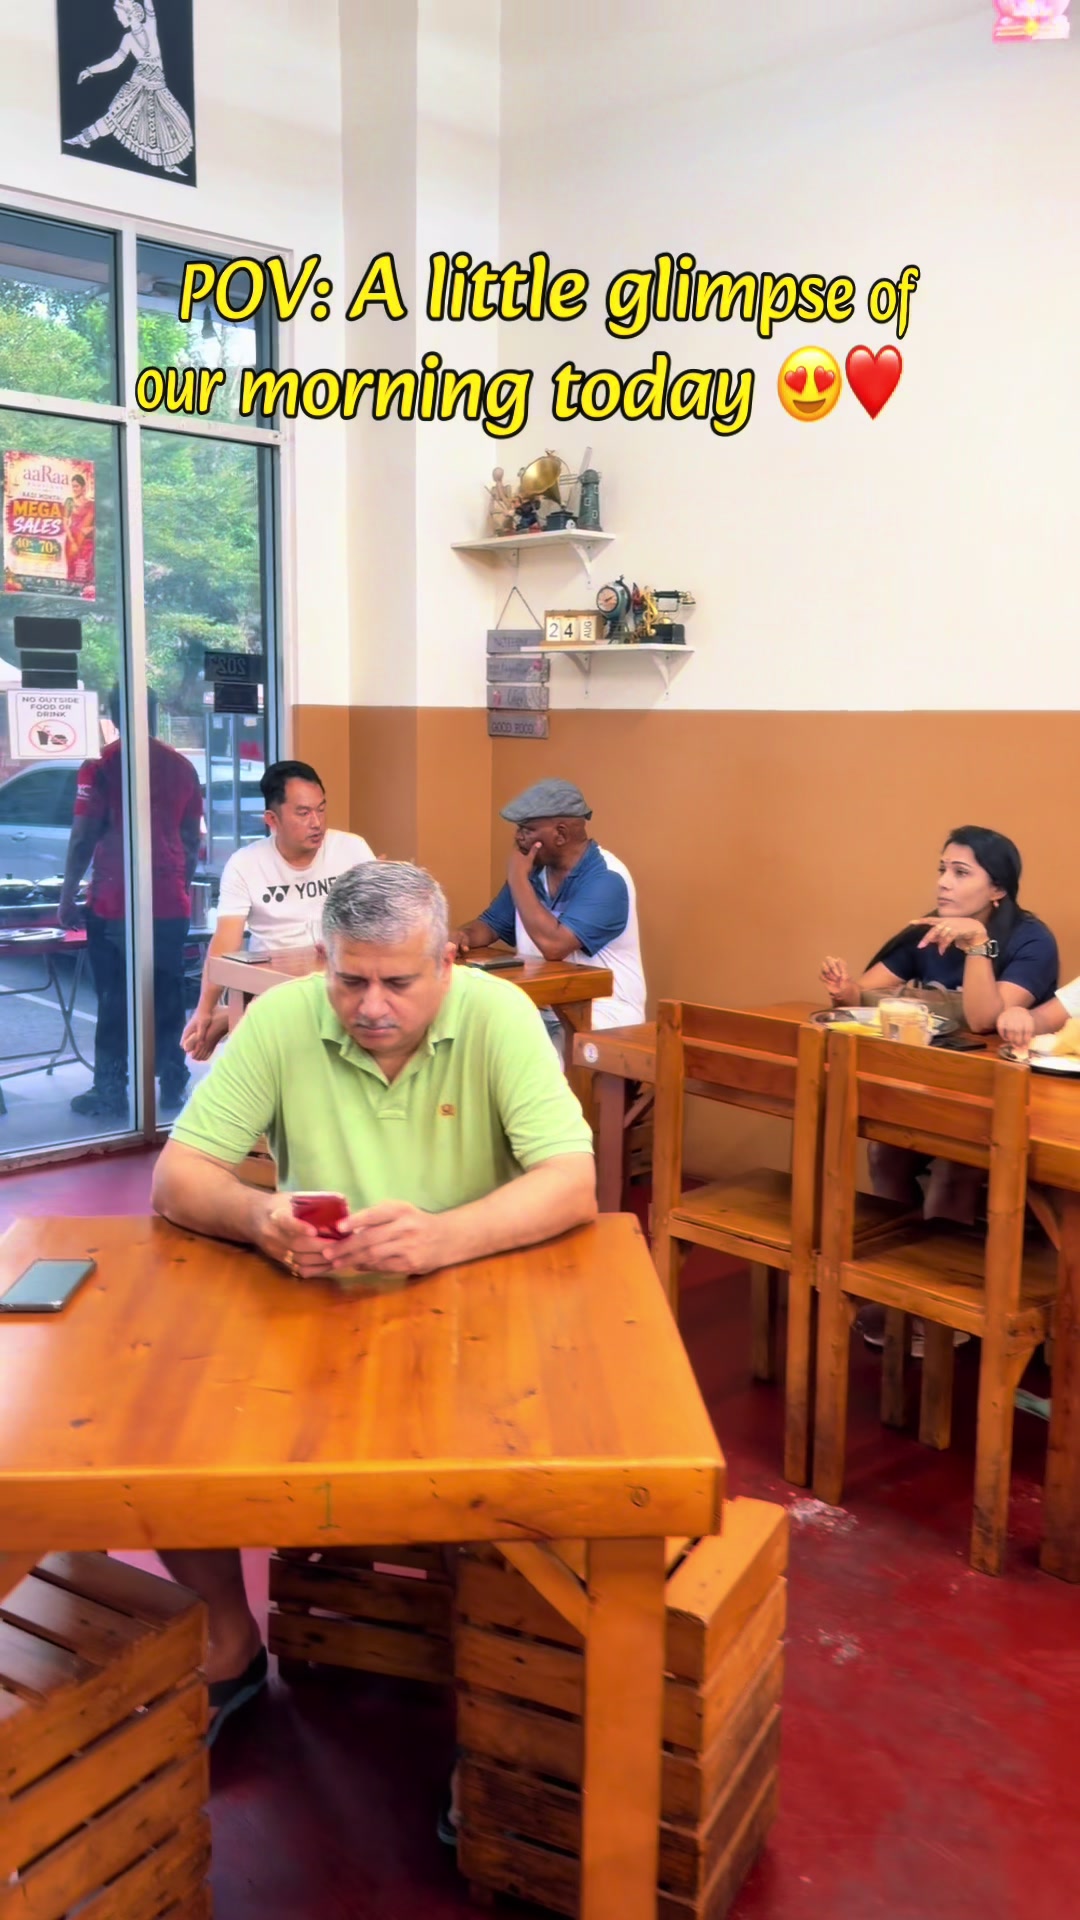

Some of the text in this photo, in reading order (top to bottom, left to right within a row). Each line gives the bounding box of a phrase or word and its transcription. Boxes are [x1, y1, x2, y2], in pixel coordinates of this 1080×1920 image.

[22, 465, 70, 486] aaRaa
[12, 500, 62, 518] MEGA
[12, 516, 63, 535] SALES
[583, 620, 592, 639] AUG
[38, 696, 80, 704] OUTSIDE
[295, 876, 337, 899] YON
